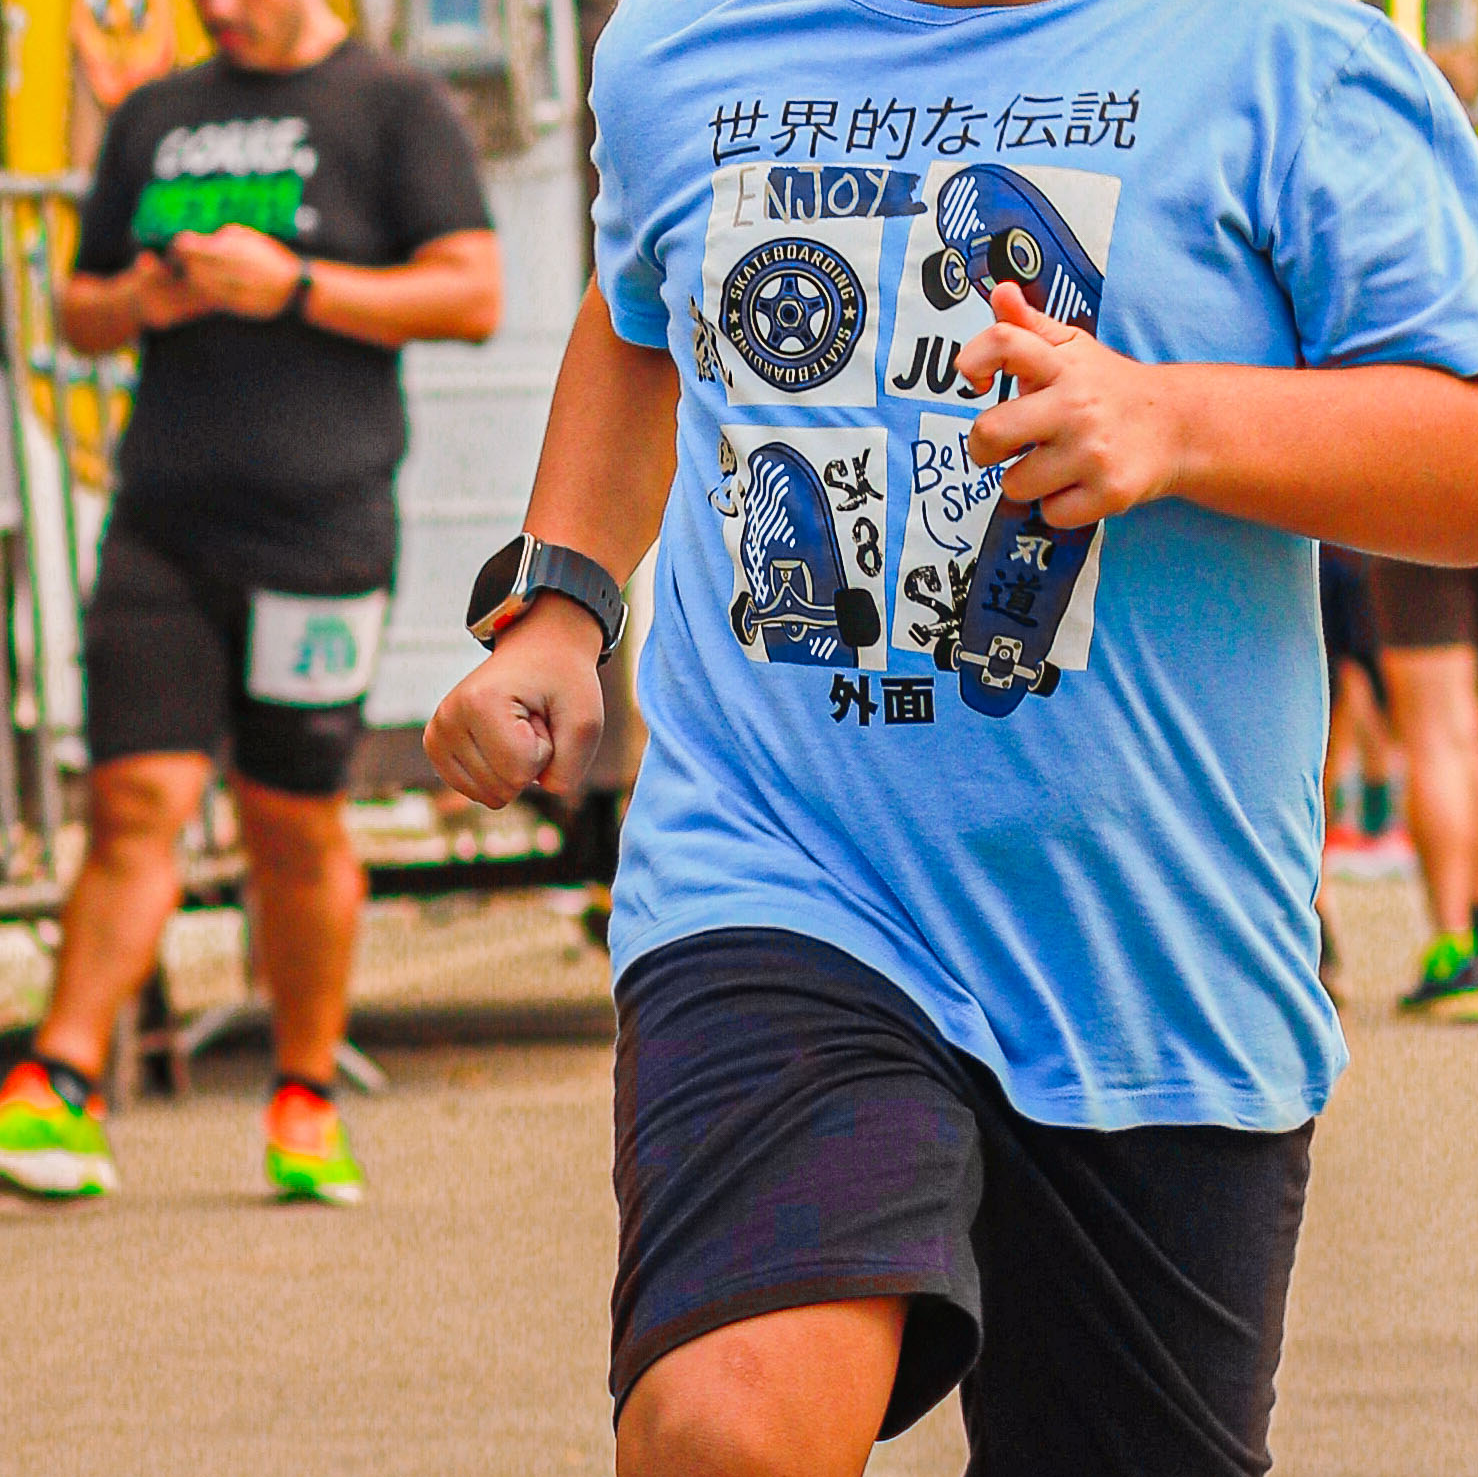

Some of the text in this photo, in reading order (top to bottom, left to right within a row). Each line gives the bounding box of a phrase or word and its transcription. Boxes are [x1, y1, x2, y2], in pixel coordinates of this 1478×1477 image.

[708, 89, 1140, 166] 世界的な伝説
[733, 165, 890, 228] ENJOY
[729, 242, 856, 302] SKATEBOARDING
[730, 326, 853, 384] SKATEBOARDING
[824, 448, 883, 511] SK
[911, 439, 955, 494] Be
[829, 673, 935, 728] 外面
